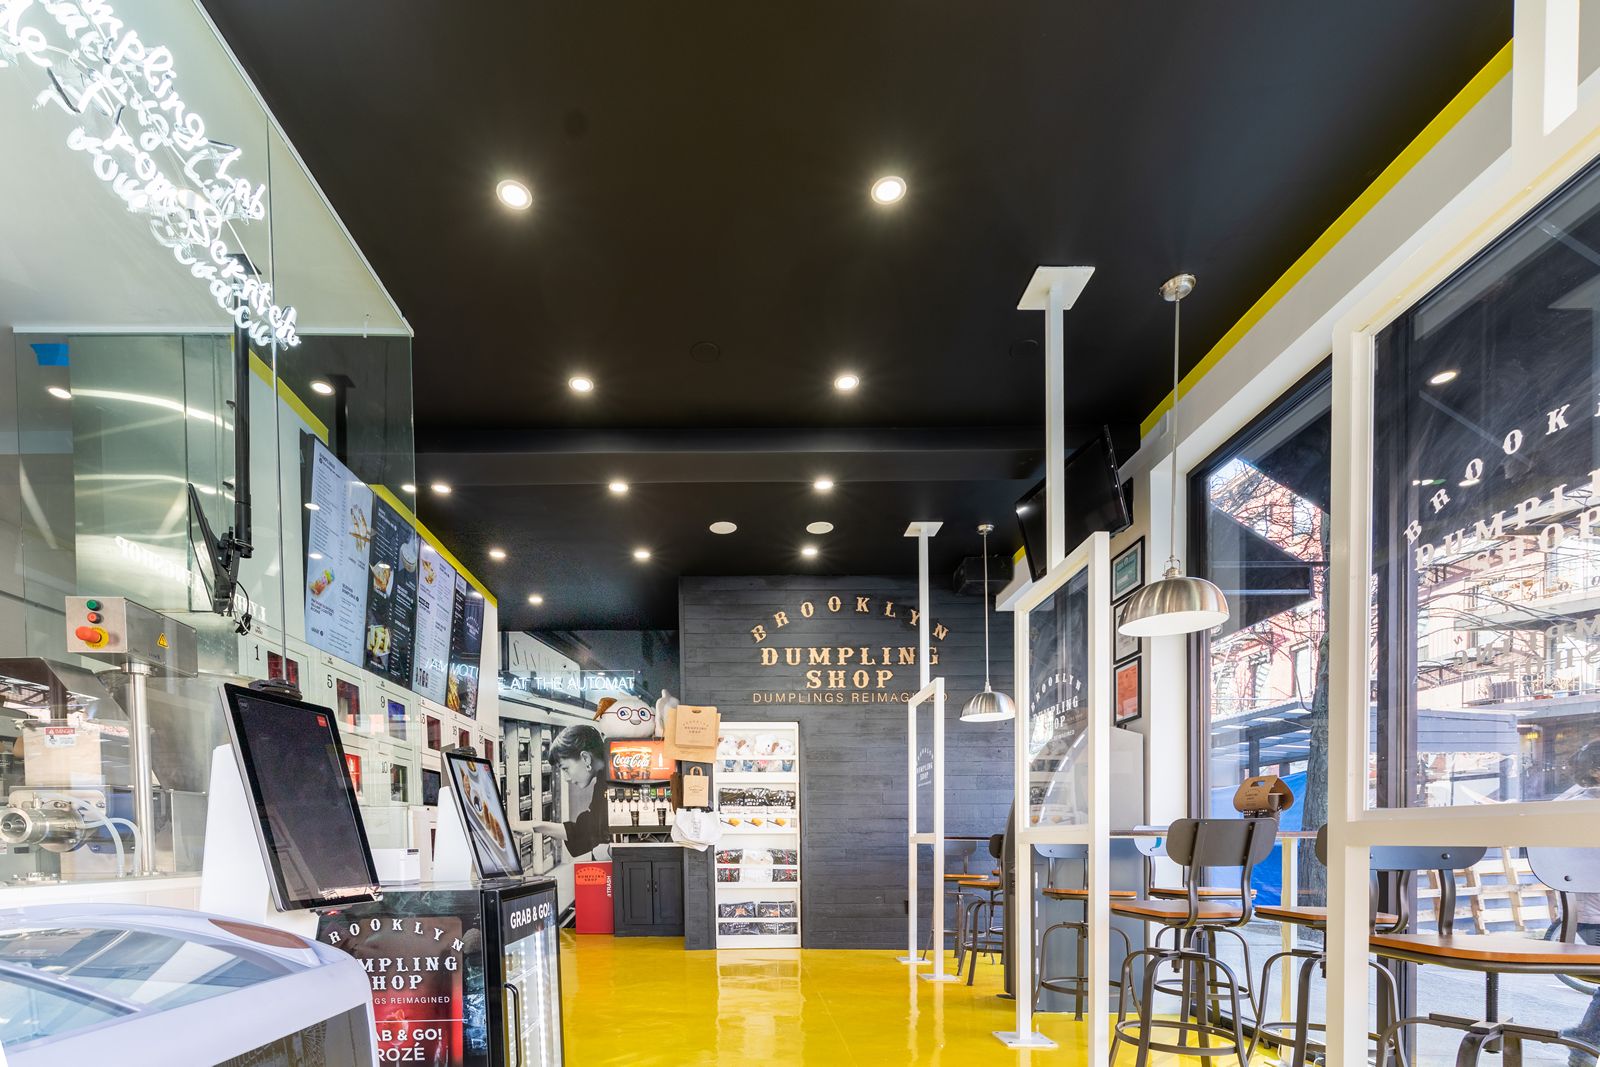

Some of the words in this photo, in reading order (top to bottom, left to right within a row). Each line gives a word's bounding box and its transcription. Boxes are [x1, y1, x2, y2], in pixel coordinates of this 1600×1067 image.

[1403, 394, 1600, 545] BROOK
[1414, 469, 1600, 572] DUMPL
[750, 595, 950, 644] BROOKLYN
[254, 645, 260, 661] 1
[760, 646, 939, 666] DUMPLING
[327, 675, 333, 688] 5
[510, 676, 528, 690] AT
[535, 676, 563, 690] THE
[567, 676, 636, 691] AUTOMAT
[806, 669, 894, 688] SHOP
[380, 696, 386, 708] 9
[753, 692, 844, 703] DUMPLINGS
[510, 907, 532, 929] GRAB
[532, 907, 538, 921] &
[538, 902, 550, 920] GO!
[328, 918, 465, 952] ROOKLYN
[356, 956, 458, 972] MPLING
[371, 974, 424, 990] HOP
[390, 996, 450, 1004] REIMAGINED
[397, 1029, 408, 1041] &
[412, 1029, 442, 1041] GO!
[377, 1043, 426, 1062] ROZÉ
